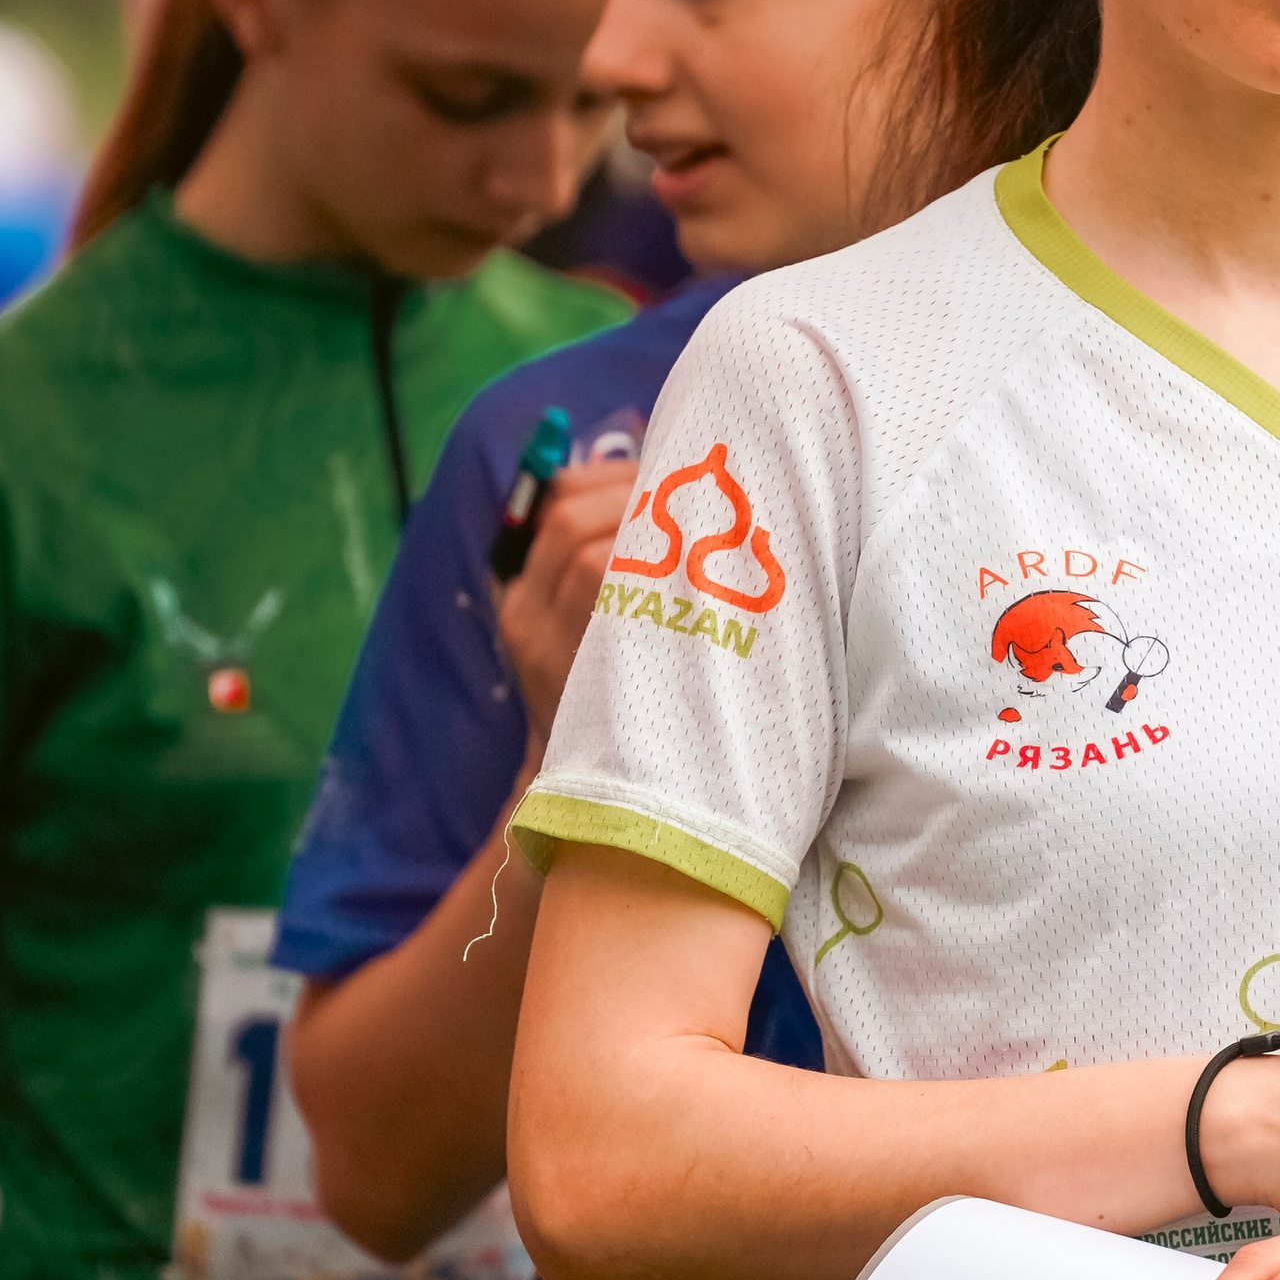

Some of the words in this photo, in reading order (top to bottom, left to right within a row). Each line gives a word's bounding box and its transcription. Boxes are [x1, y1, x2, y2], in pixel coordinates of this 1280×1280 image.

[978, 550, 1147, 599] ARDF
[595, 583, 758, 659] RYAZAN
[985, 723, 1171, 770] РЯЗАНЬ
[1135, 1218, 1272, 1249] РОССИЙСКИЕ
